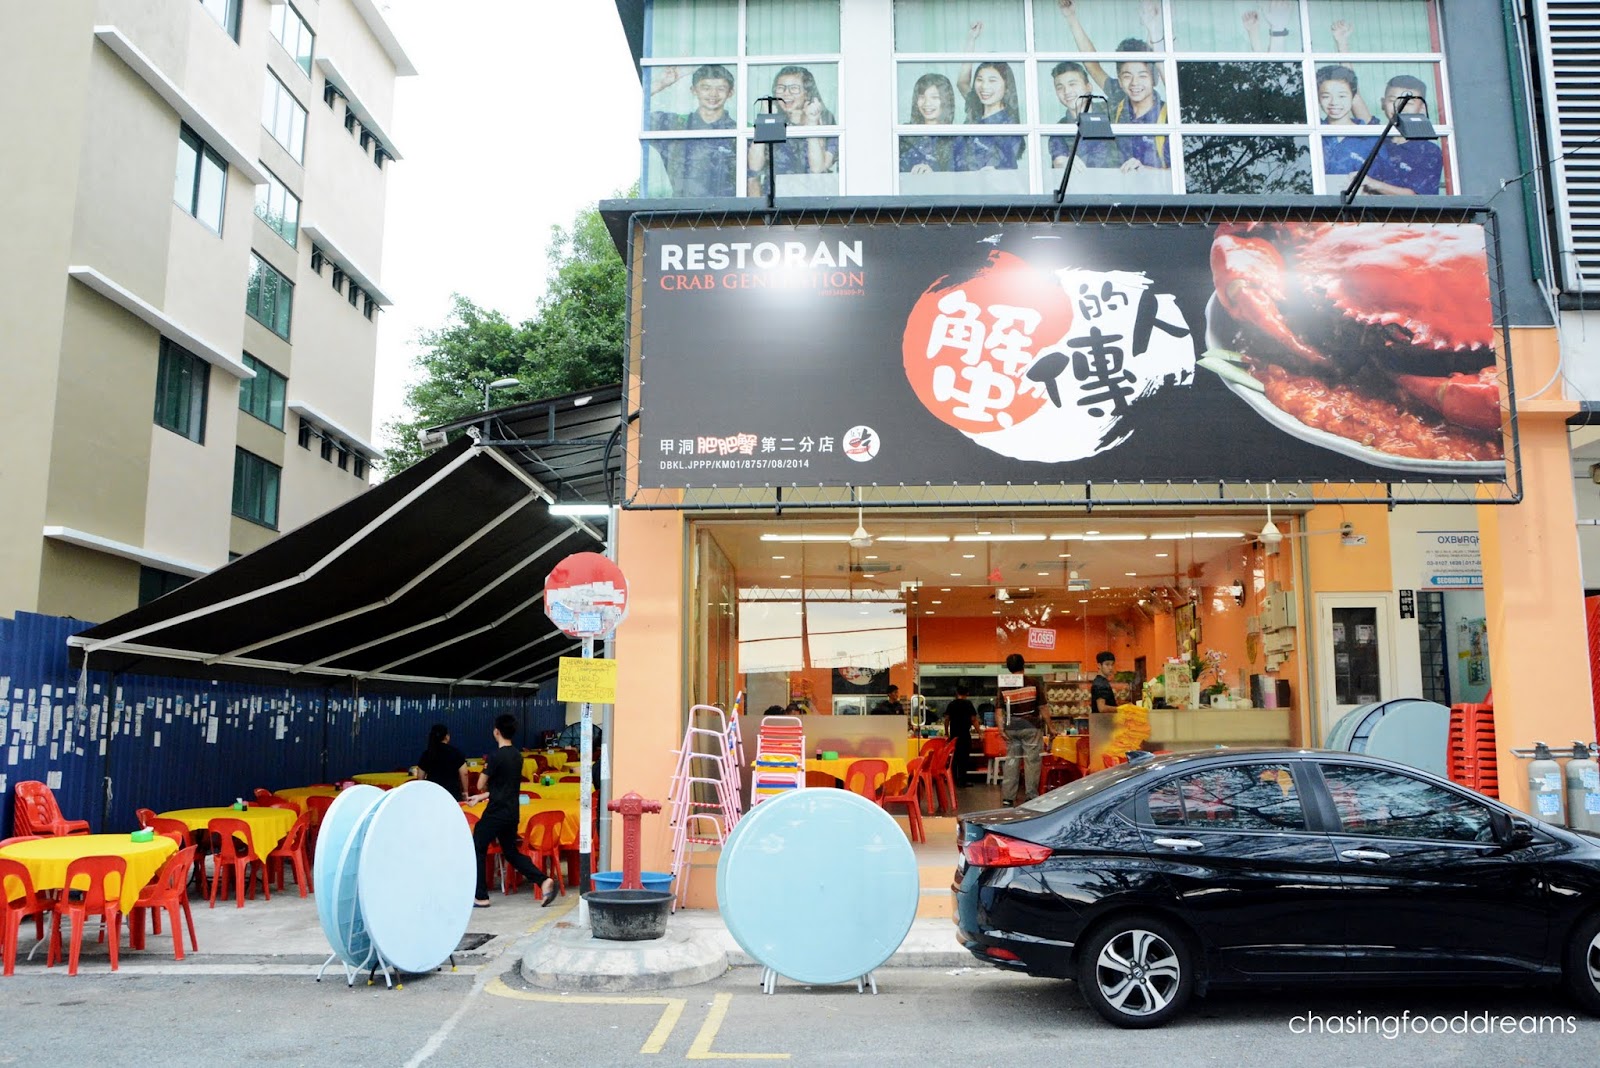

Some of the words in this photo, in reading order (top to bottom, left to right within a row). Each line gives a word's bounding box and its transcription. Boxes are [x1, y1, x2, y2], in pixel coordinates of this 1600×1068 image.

[661, 240, 863, 271] RESTORAN
[660, 274, 715, 290] CRAB
[722, 271, 865, 290] GENTION
[1030, 631, 1054, 645] CLOSED
